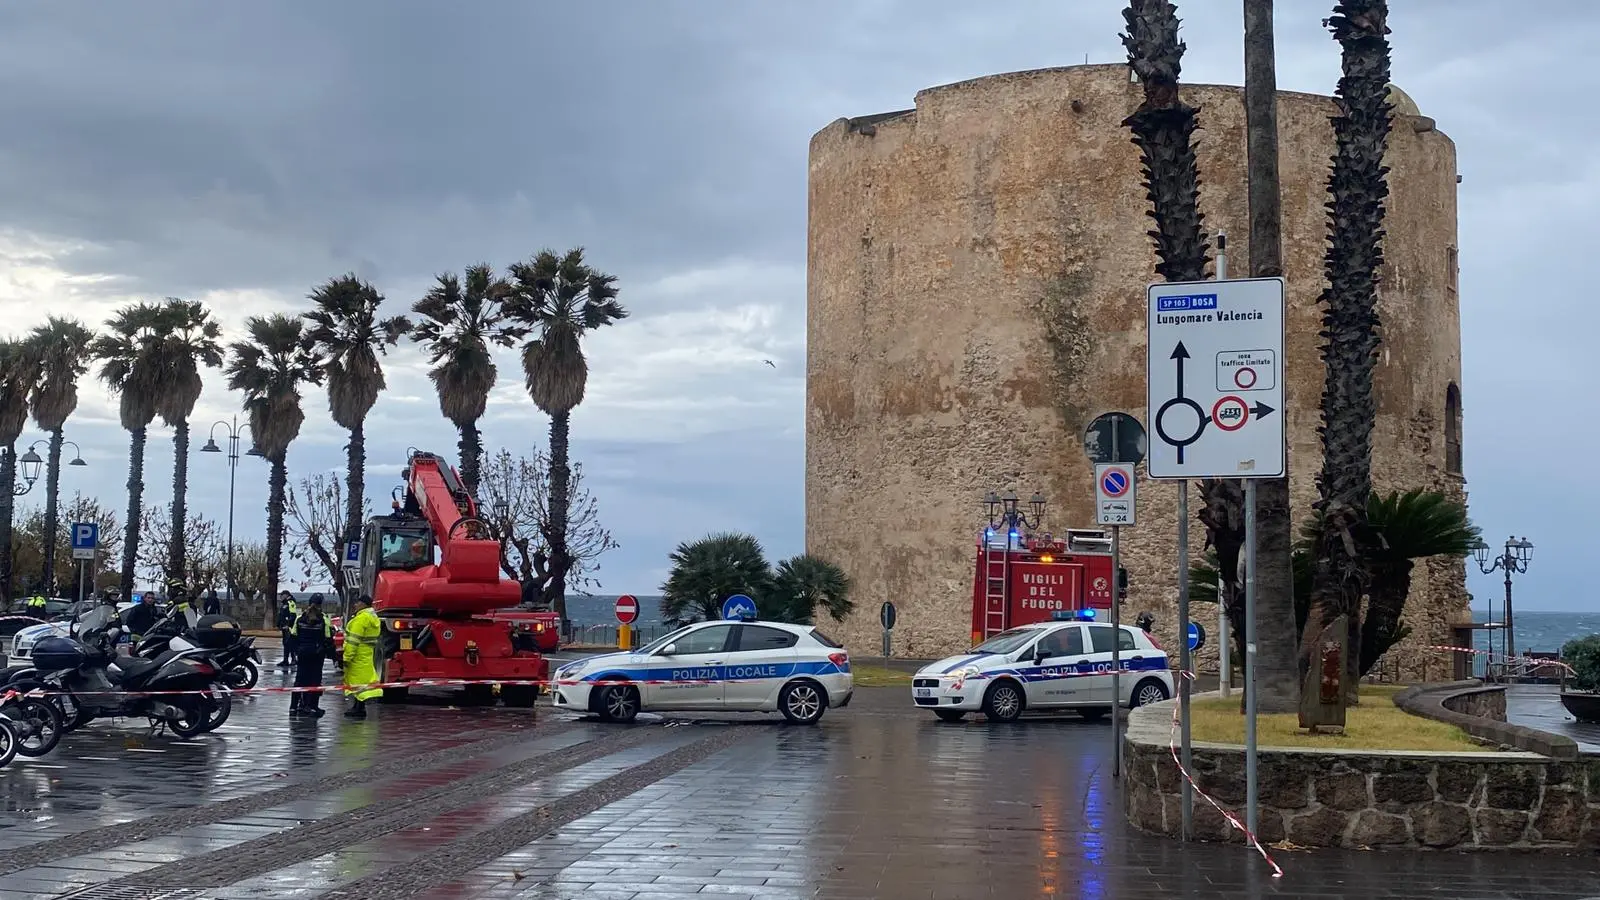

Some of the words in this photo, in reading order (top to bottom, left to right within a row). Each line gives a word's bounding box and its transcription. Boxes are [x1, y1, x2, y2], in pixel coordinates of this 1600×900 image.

[1174, 299, 1186, 307] 105
[1192, 298, 1214, 306] BOSA
[1157, 313, 1213, 326] Lungomare
[1217, 309, 1263, 321] Valencia
[1116, 514, 1127, 522] 24
[77, 525, 93, 545] P
[350, 544, 357, 552] P
[1023, 574, 1064, 584] VIGILI
[1030, 586, 1055, 596] DEL
[1022, 599, 1063, 609] FUOCO
[672, 669, 719, 680] POLIZIA
[728, 665, 777, 678] LOCALE
[1041, 666, 1079, 679] POLIZIA
[1092, 661, 1130, 672] LOCLE
